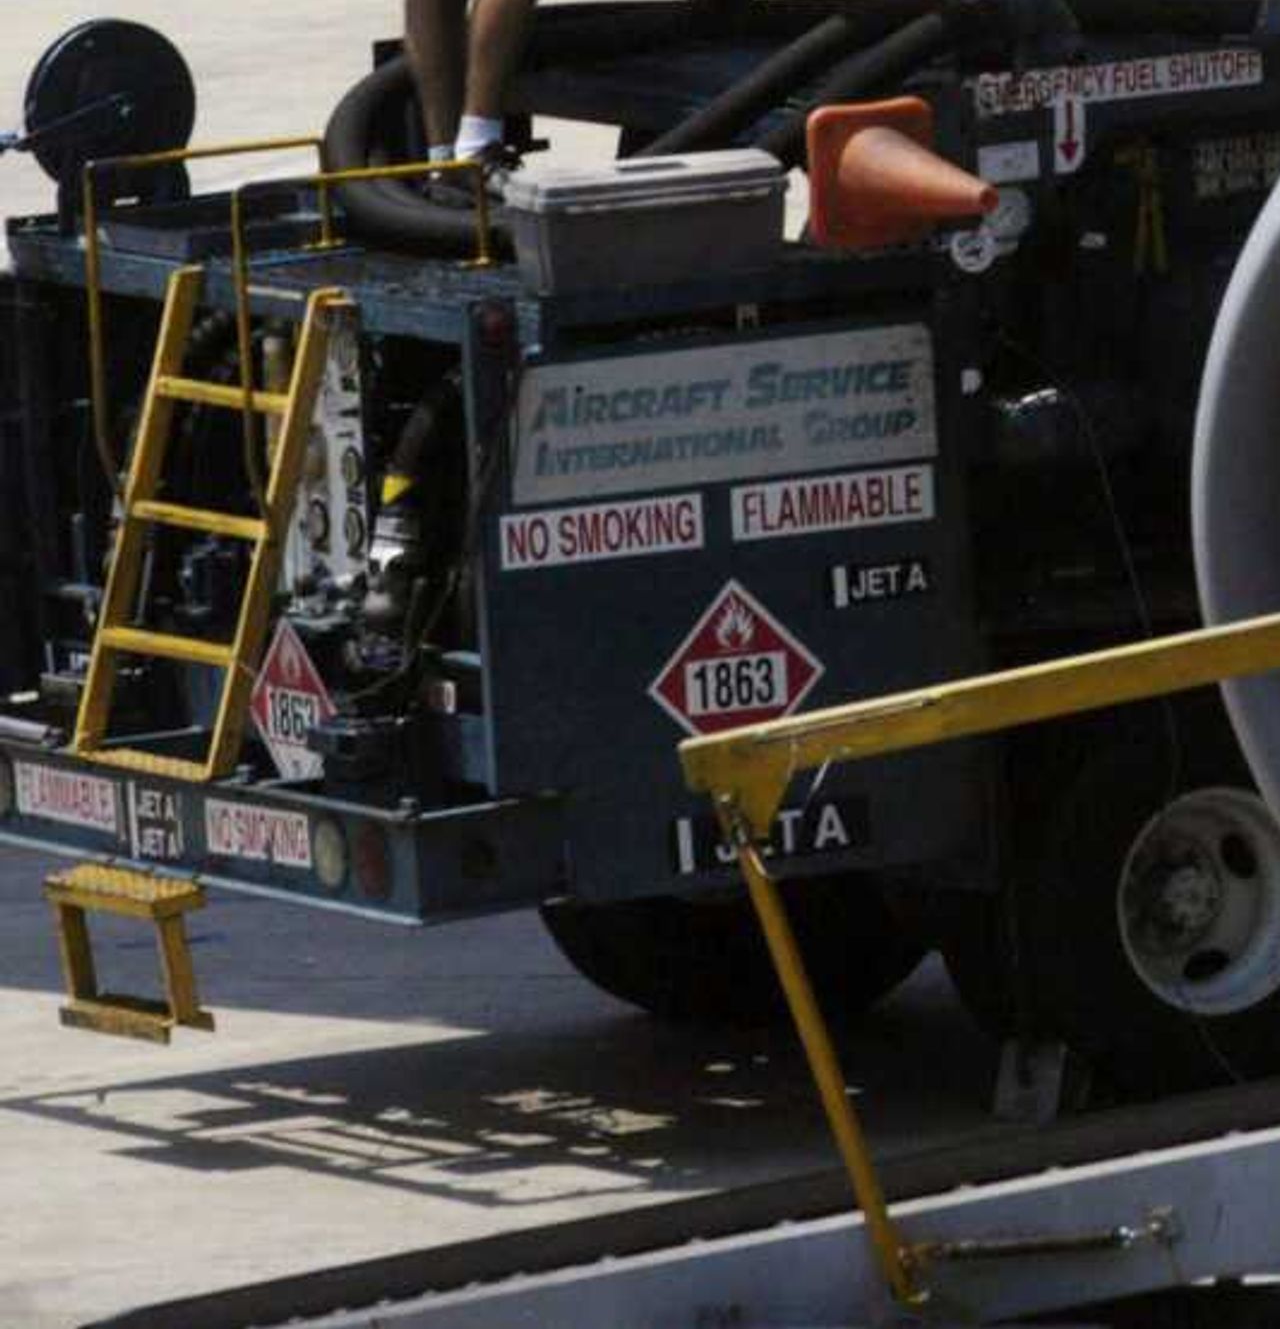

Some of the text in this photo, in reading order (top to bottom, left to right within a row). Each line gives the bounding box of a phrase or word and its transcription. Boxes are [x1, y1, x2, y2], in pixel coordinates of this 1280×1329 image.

[1112, 59, 1159, 90] FUEL
[1168, 51, 1261, 87] SHUTOFF
[741, 473, 924, 534] FLAMMABLE
[506, 500, 698, 564] NO SMOKING
[850, 563, 928, 600] JET A
[692, 656, 775, 711] 1863
[813, 804, 849, 849] A
